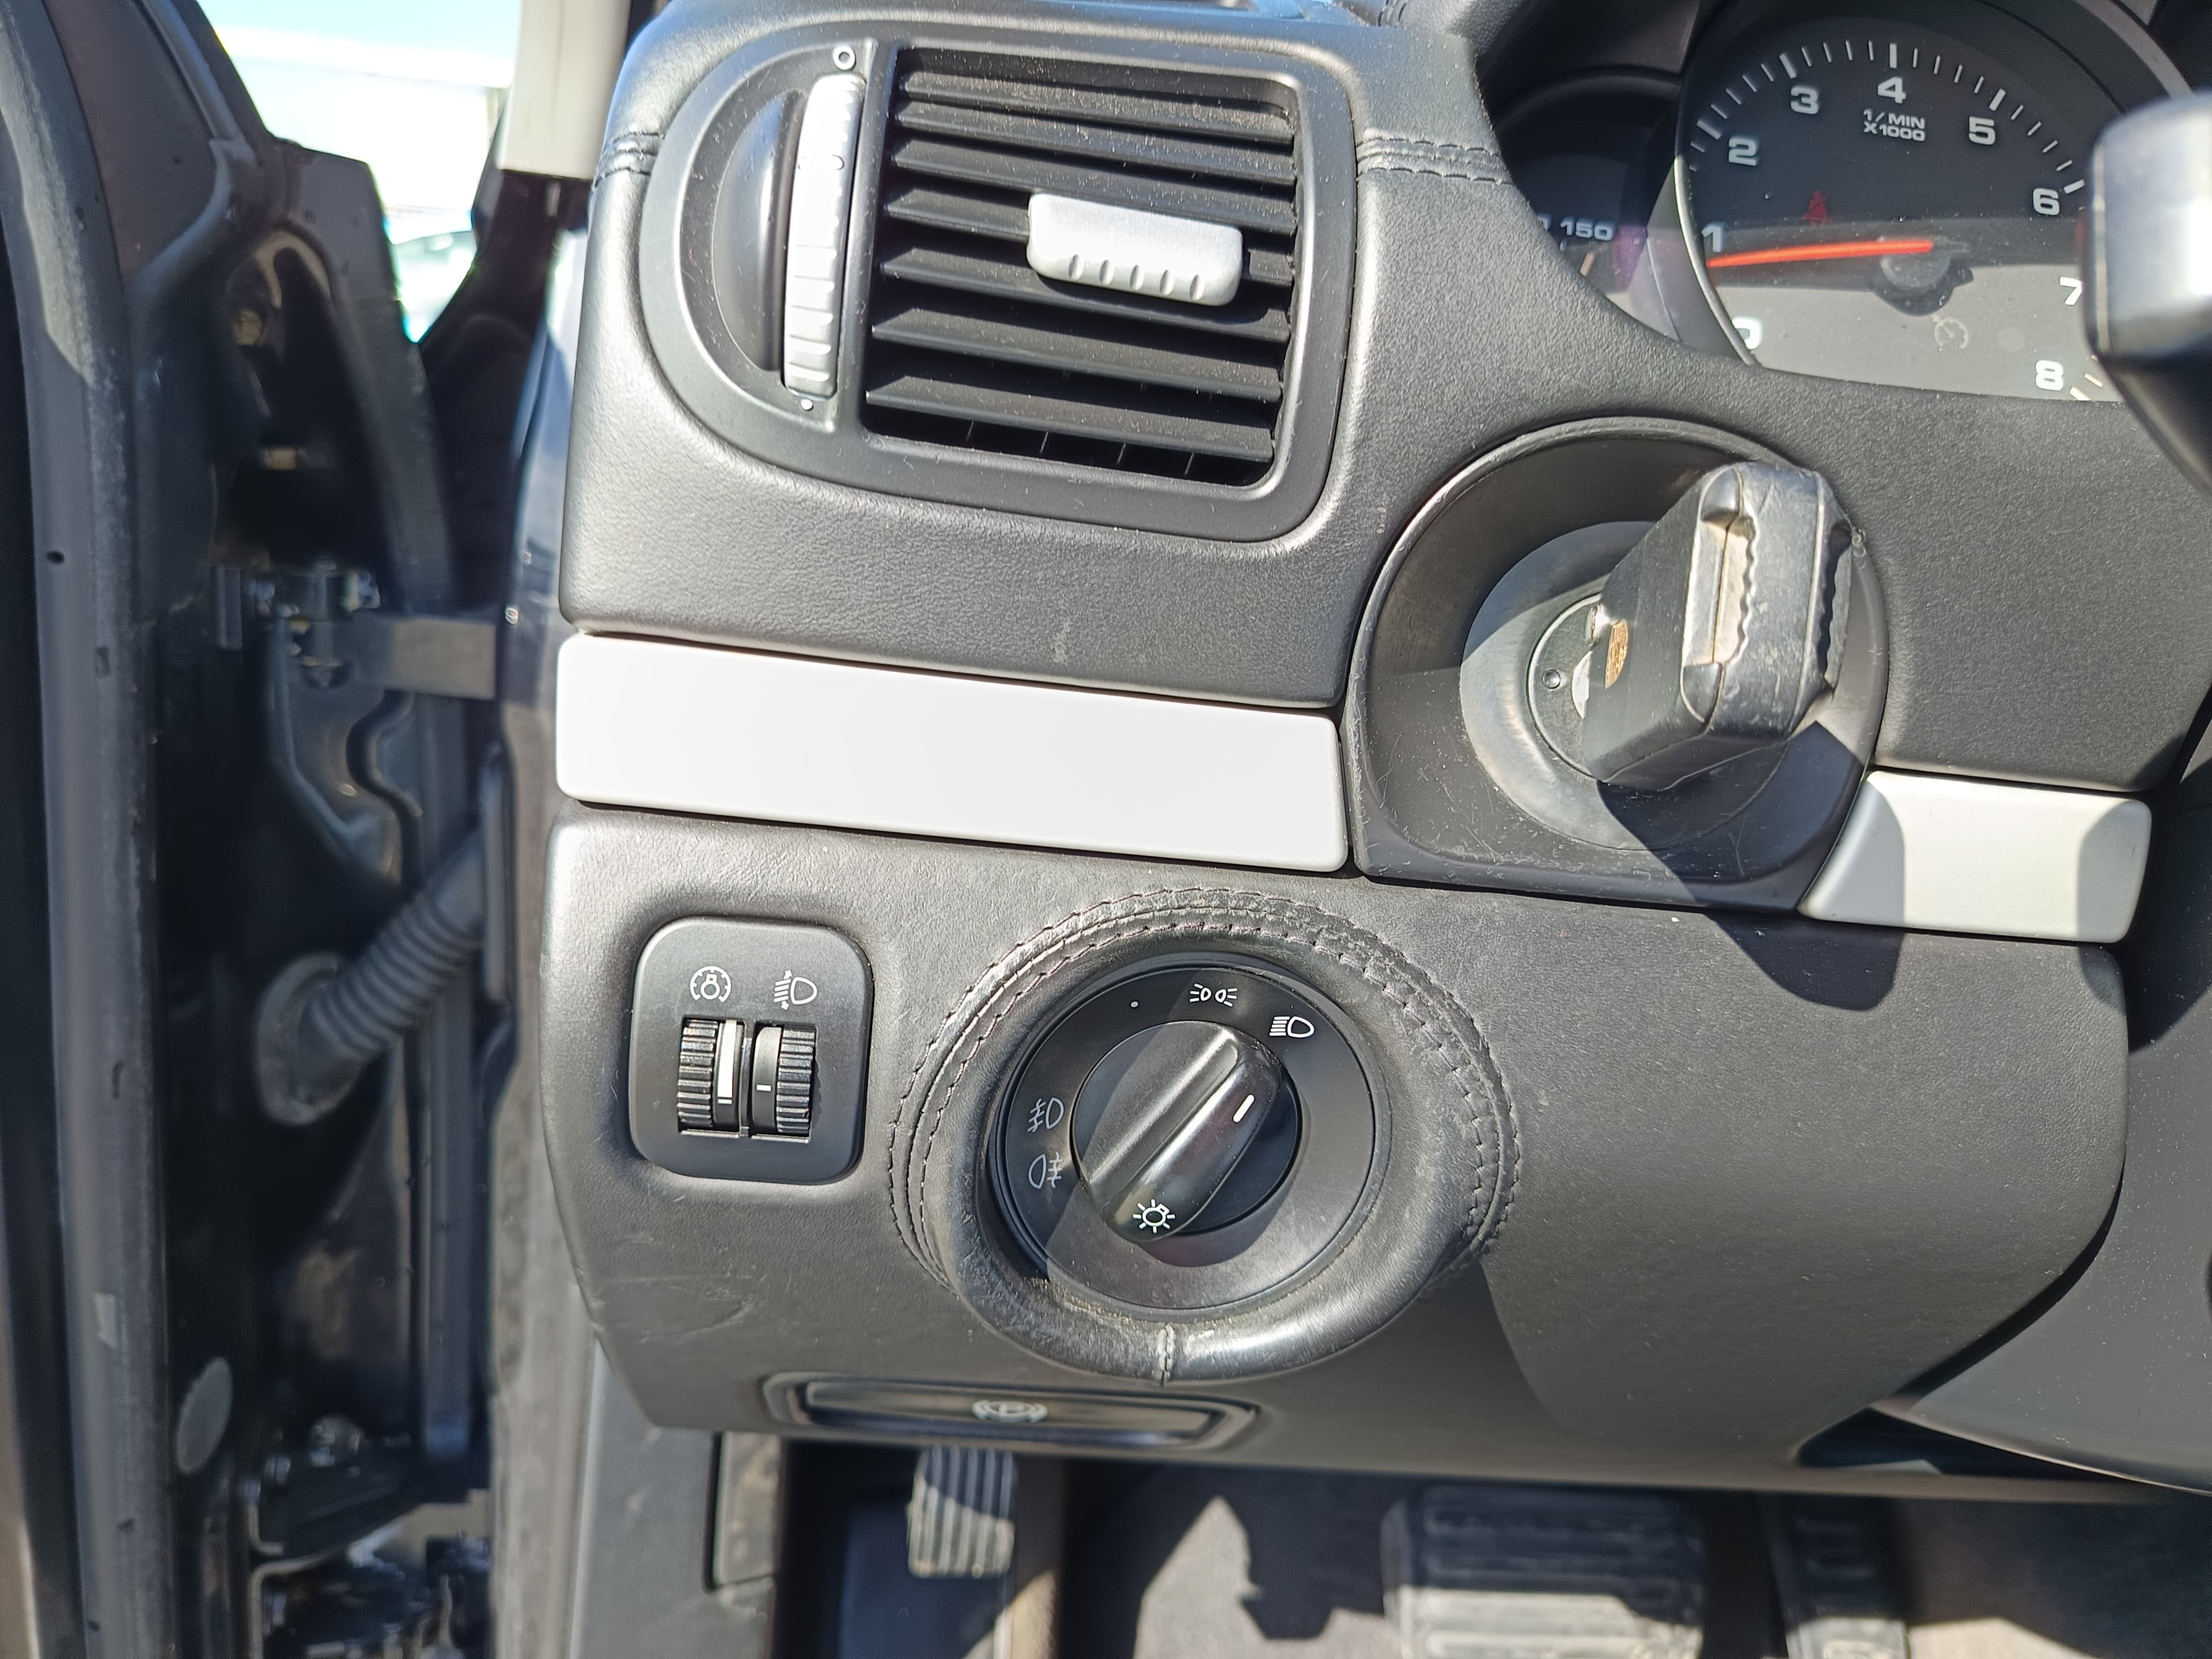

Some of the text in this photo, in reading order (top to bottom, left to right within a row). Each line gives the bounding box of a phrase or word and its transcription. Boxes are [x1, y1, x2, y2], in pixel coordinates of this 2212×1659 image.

[1790, 86, 1819, 114] 3
[1877, 76, 1906, 104] 4
[1863, 120, 1926, 142] X1000
[1969, 116, 1995, 145] 5
[1729, 137, 1757, 166] 2
[2033, 188, 2060, 216] 6
[1560, 219, 1613, 241] 150
[1701, 224, 1722, 253] 1
[2059, 276, 2083, 306] 7
[2035, 360, 2064, 391] 8
